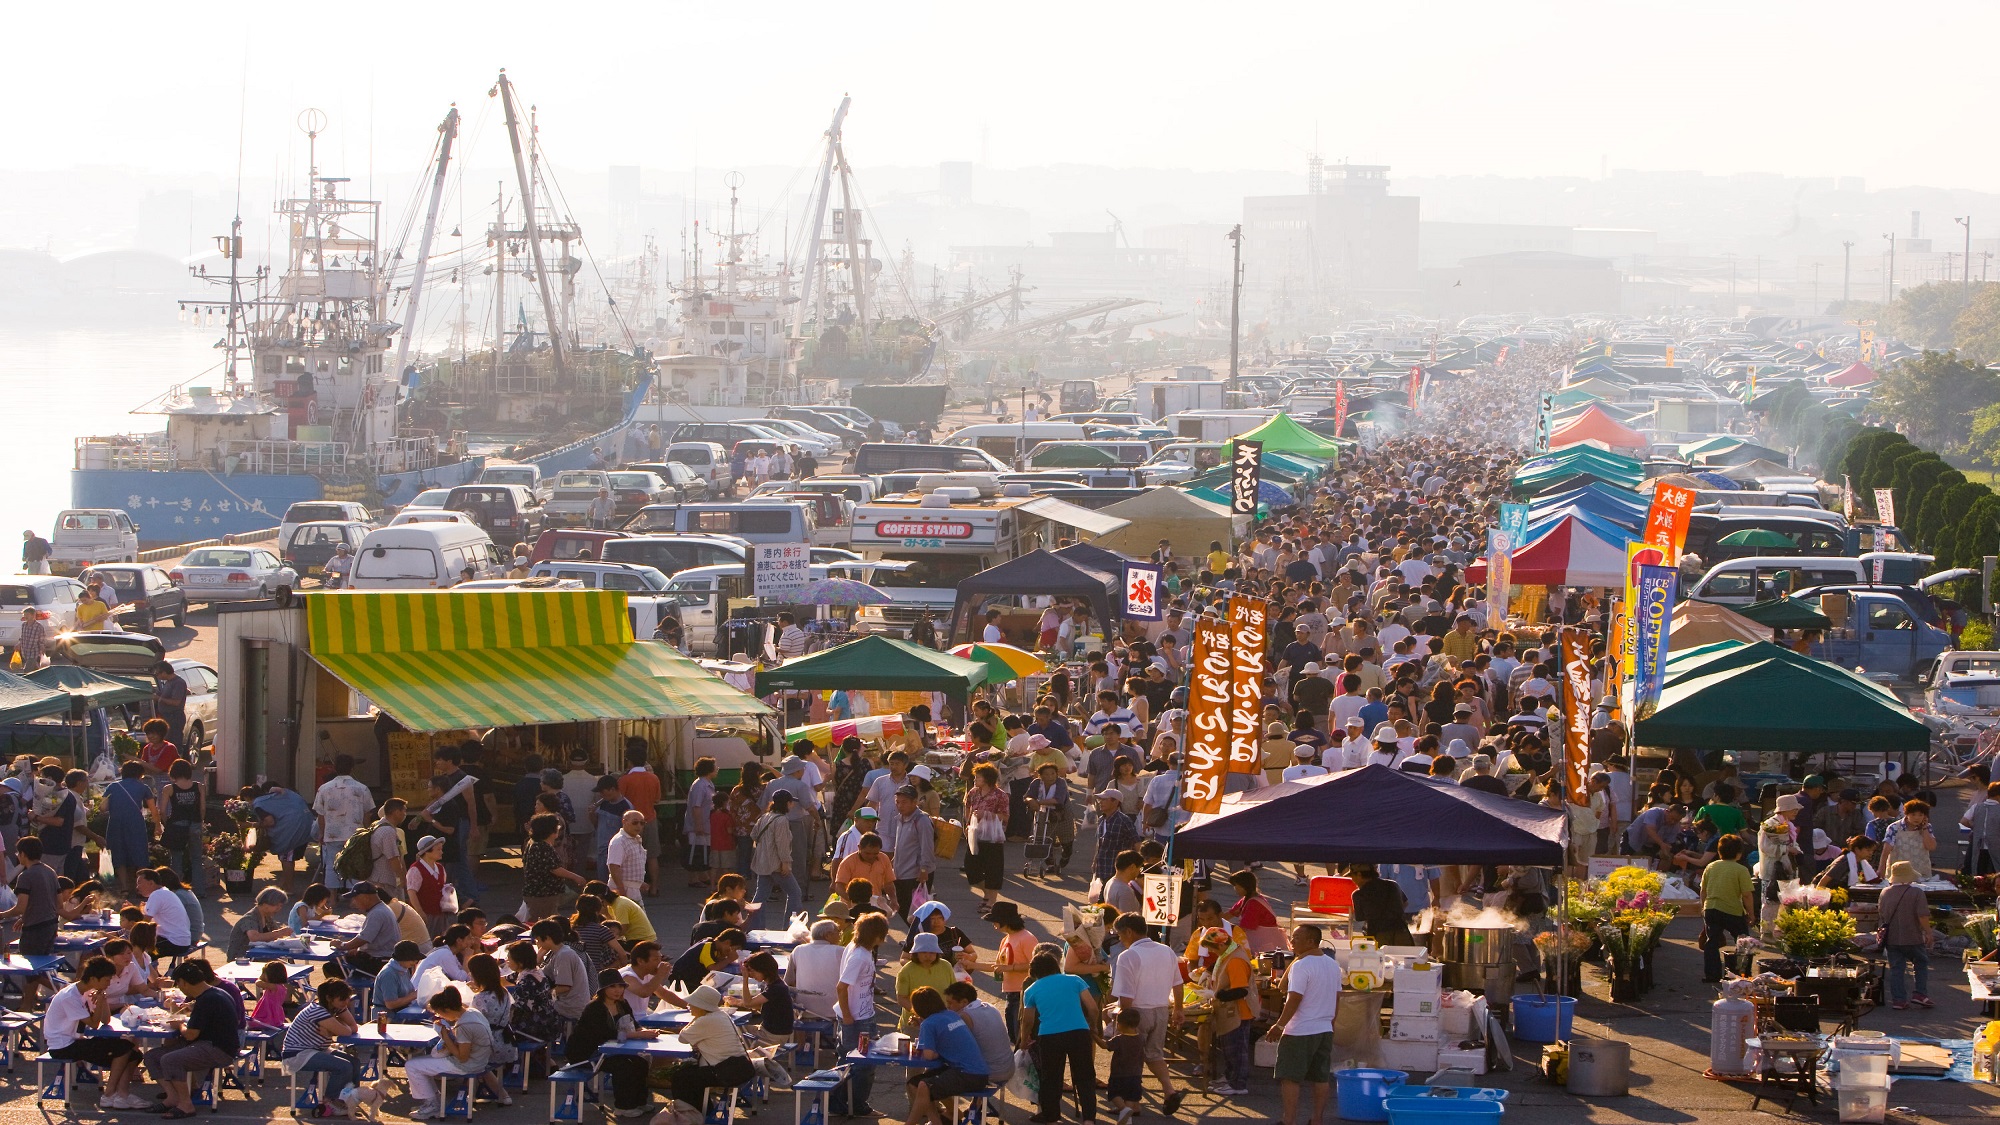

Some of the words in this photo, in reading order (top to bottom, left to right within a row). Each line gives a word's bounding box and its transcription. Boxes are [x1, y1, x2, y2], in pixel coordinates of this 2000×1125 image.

[127, 494, 267, 512] 第十一きんせい丸
[883, 524, 923, 535] COFFEE
[926, 525, 965, 536] STAND
[763, 547, 801, 559] 港内徐行
[757, 559, 808, 571] 漁港にごみを捨て
[757, 571, 804, 582] ないでください。
[1651, 577, 1670, 589] ICE
[1648, 588, 1667, 675] COFFEE
[1155, 882, 1167, 921] うどん
